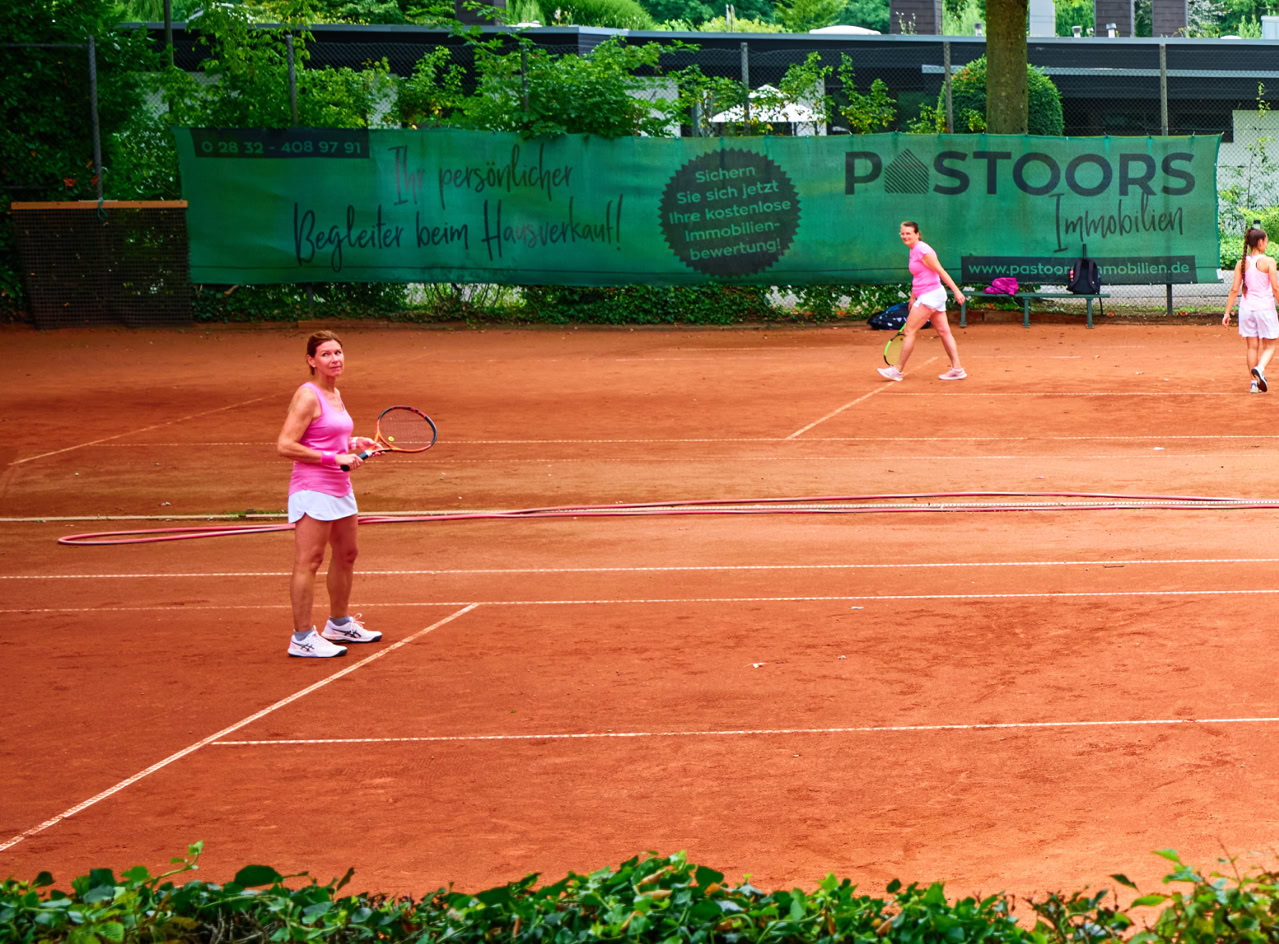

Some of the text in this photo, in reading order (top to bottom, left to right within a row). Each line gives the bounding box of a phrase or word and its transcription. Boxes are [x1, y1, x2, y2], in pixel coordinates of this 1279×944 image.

[200, 141, 214, 153] 0
[217, 141, 238, 153] 28
[243, 141, 264, 154] 32
[280, 140, 314, 153] 408
[318, 141, 338, 153] 97
[343, 141, 361, 154] 91
[388, 143, 573, 210] Ihr persönlicher
[695, 166, 756, 183] Sichern
[676, 179, 780, 204] Sie sich jetzt
[669, 200, 792, 225] Ihre kostenlose
[1048, 191, 1184, 254] Immobilien
[294, 193, 623, 272] Begleiter beim Hausverkauf!
[684, 221, 781, 242] Immobilien-
[689, 237, 782, 261] bewertung!
